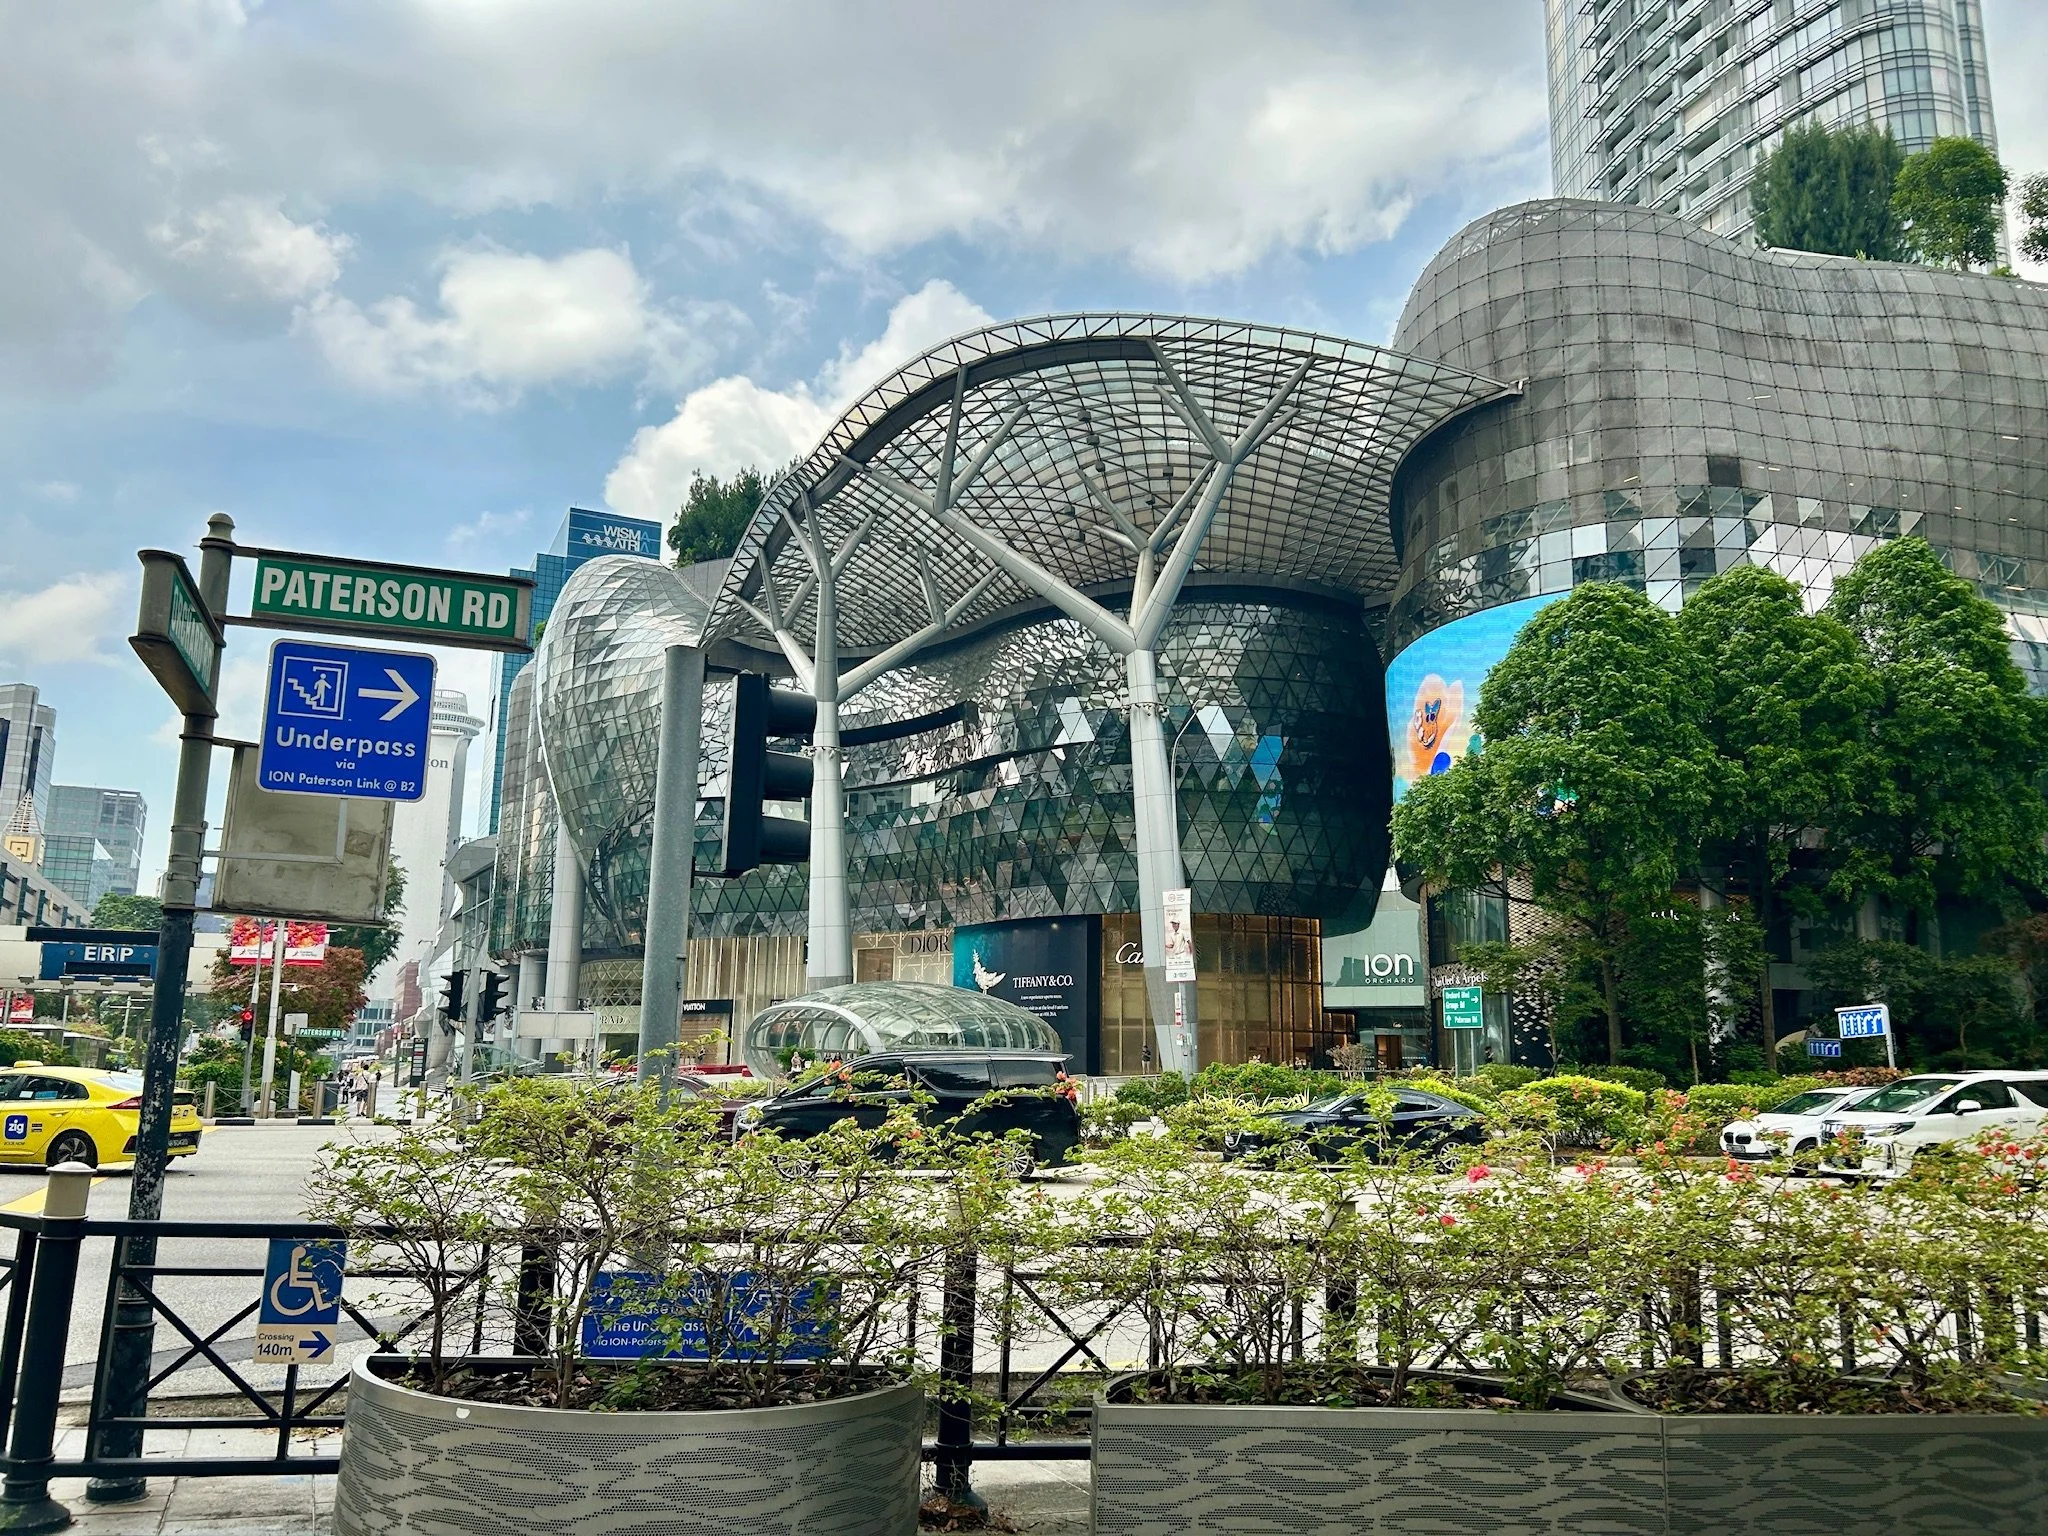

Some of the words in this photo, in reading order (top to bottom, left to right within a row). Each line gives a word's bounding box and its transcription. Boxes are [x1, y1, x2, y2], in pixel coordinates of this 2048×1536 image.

[603, 525, 649, 542] WISMA
[613, 538, 649, 553] ATRIA
[260, 567, 451, 623] PATERSON
[461, 590, 510, 629] RD
[276, 726, 416, 758] Underpass
[335, 758, 356, 770] via
[268, 771, 294, 783] ION
[299, 773, 353, 787] Paterson
[356, 778, 381, 790] Link
[384, 780, 397, 792] @
[400, 781, 415, 792] B2
[910, 935, 950, 953] DIOR
[1365, 977, 1414, 985] ORCHARD
[300, 1029, 331, 1037] PATERSON
[8, 1119, 24, 1135] zig
[258, 1333, 295, 1341] Crossing
[257, 1343, 292, 1356] 140m
